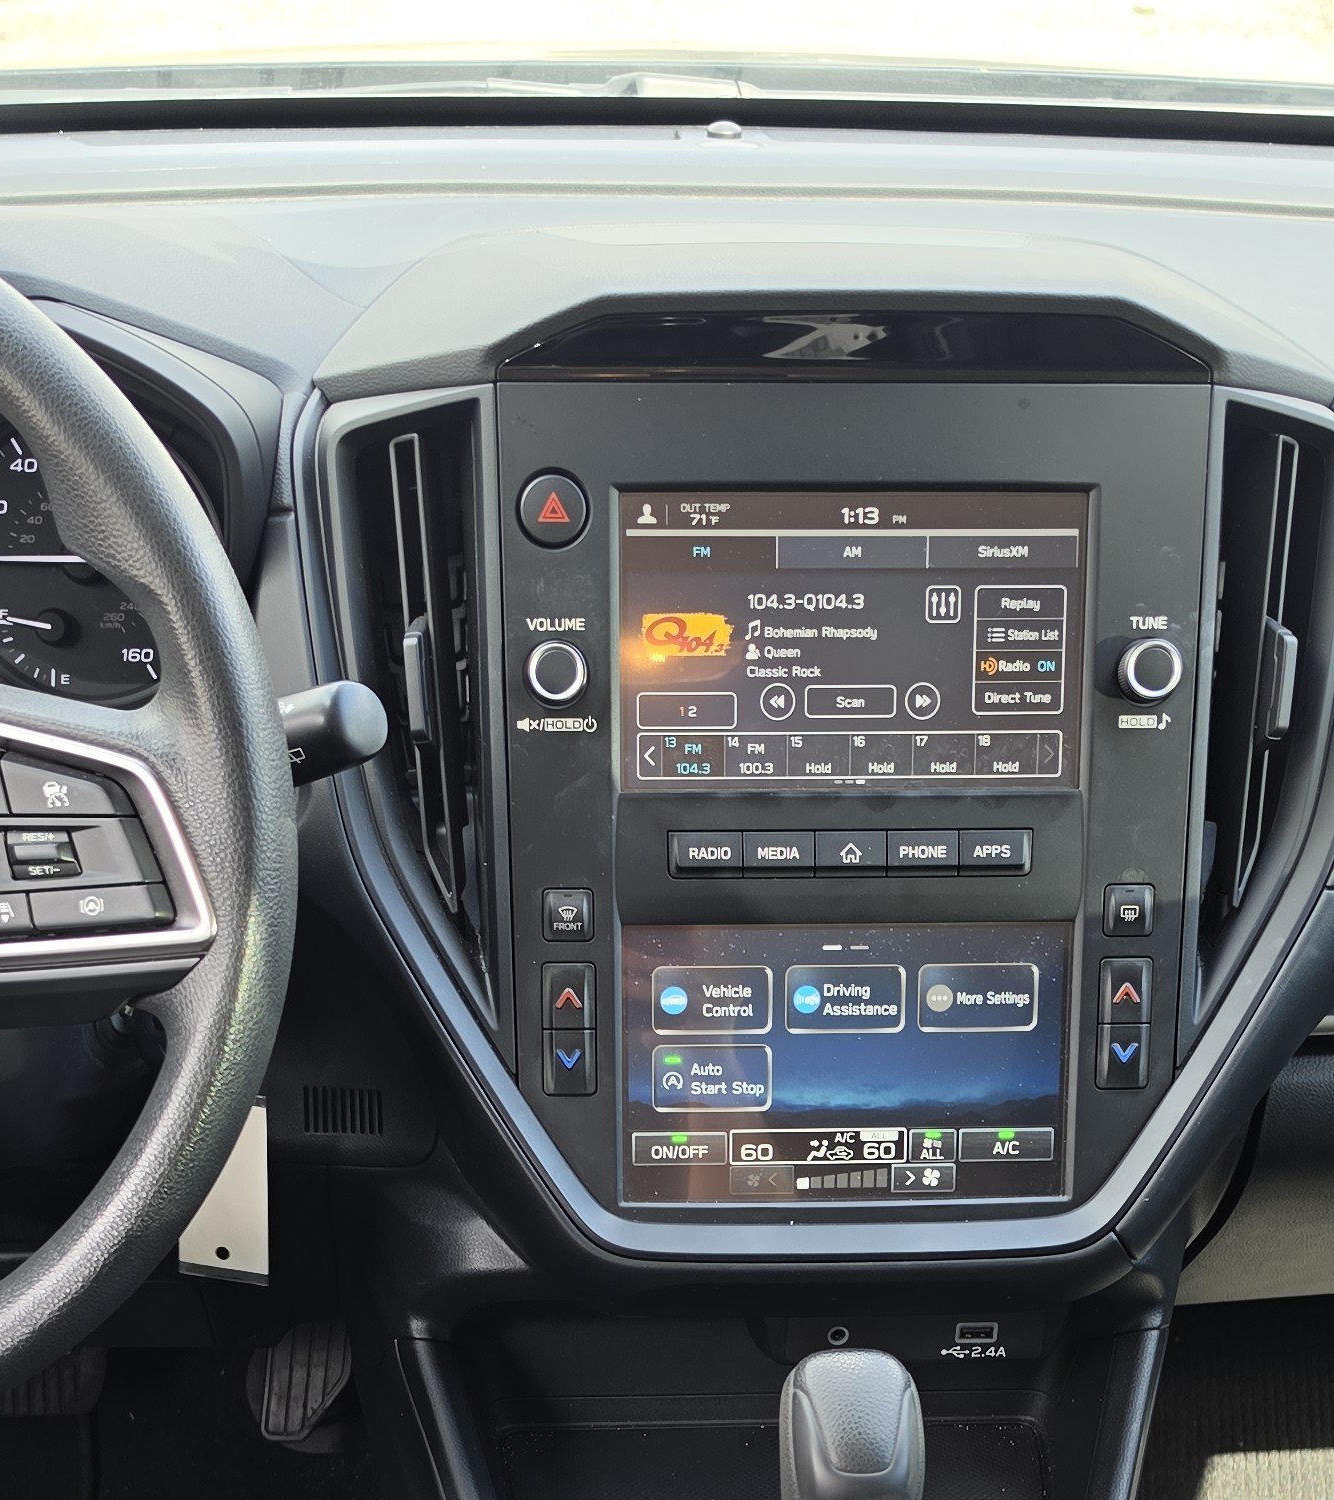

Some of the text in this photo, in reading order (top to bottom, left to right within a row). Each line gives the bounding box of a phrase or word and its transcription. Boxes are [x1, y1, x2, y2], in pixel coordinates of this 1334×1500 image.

[9, 458, 38, 473] 40
[680, 503, 731, 513] OUT TEMP
[26, 515, 43, 525] 40
[840, 506, 907, 525] 1:13 PM
[19, 534, 36, 544] 20
[692, 546, 711, 558] FM
[842, 546, 862, 558] AM
[977, 545, 1029, 558] SiriusXM
[747, 593, 865, 610] 104.3-Q104.3
[1000, 597, 1041, 611] Replay
[0, 608, 9, 620] F
[103, 612, 125, 622] 260
[526, 618, 586, 631] VOLUME
[1129, 616, 1168, 630] TUNE
[764, 626, 878, 641] Bohemian Rhapsody
[1007, 628, 1059, 641] Station List
[121, 648, 154, 663] 160
[764, 646, 801, 659] Queen
[746, 665, 822, 677] Classic Rock
[998, 661, 1030, 672] Radio
[1037, 661, 1056, 672] ON
[60, 674, 71, 685] E
[836, 695, 865, 708] Scan
[984, 692, 1052, 704] Direct Tune
[688, 706, 698, 717] 2
[547, 720, 582, 730] HOLD
[1120, 717, 1155, 727] HOLD
[665, 737, 677, 748] 13
[727, 737, 739, 748] 14
[790, 737, 803, 748] 15
[853, 736, 866, 748] 16
[915, 736, 928, 747] 17
[978, 735, 991, 747] 18
[684, 744, 702, 755] FM
[747, 744, 765, 755] FM
[676, 763, 711, 775] 104.3
[739, 763, 774, 775] 100.3
[806, 763, 832, 774] Hold
[868, 762, 895, 774] Hold
[930, 762, 957, 774] Hold
[993, 761, 1020, 773] Hold
[689, 847, 732, 860] RADIO
[757, 847, 800, 860] MEDIA
[899, 845, 947, 858] PHONE
[973, 845, 1012, 858] APPS
[553, 922, 583, 931] FRONT
[702, 984, 753, 998] Vehicle
[823, 983, 871, 999] Driving
[956, 991, 1030, 1007] More Settings
[702, 1003, 754, 1017] Control
[823, 1002, 898, 1016] Assistance
[690, 1063, 723, 1076] Auto
[690, 1082, 765, 1097] Start Stop
[834, 1132, 856, 1143] A/C
[650, 1145, 709, 1160] ON/OFF
[740, 1144, 774, 1161] 60
[863, 1142, 897, 1159] 60
[993, 1141, 1020, 1155] A/C
[920, 1149, 945, 1160] ALL
[971, 1346, 1006, 1358] 2.4A
